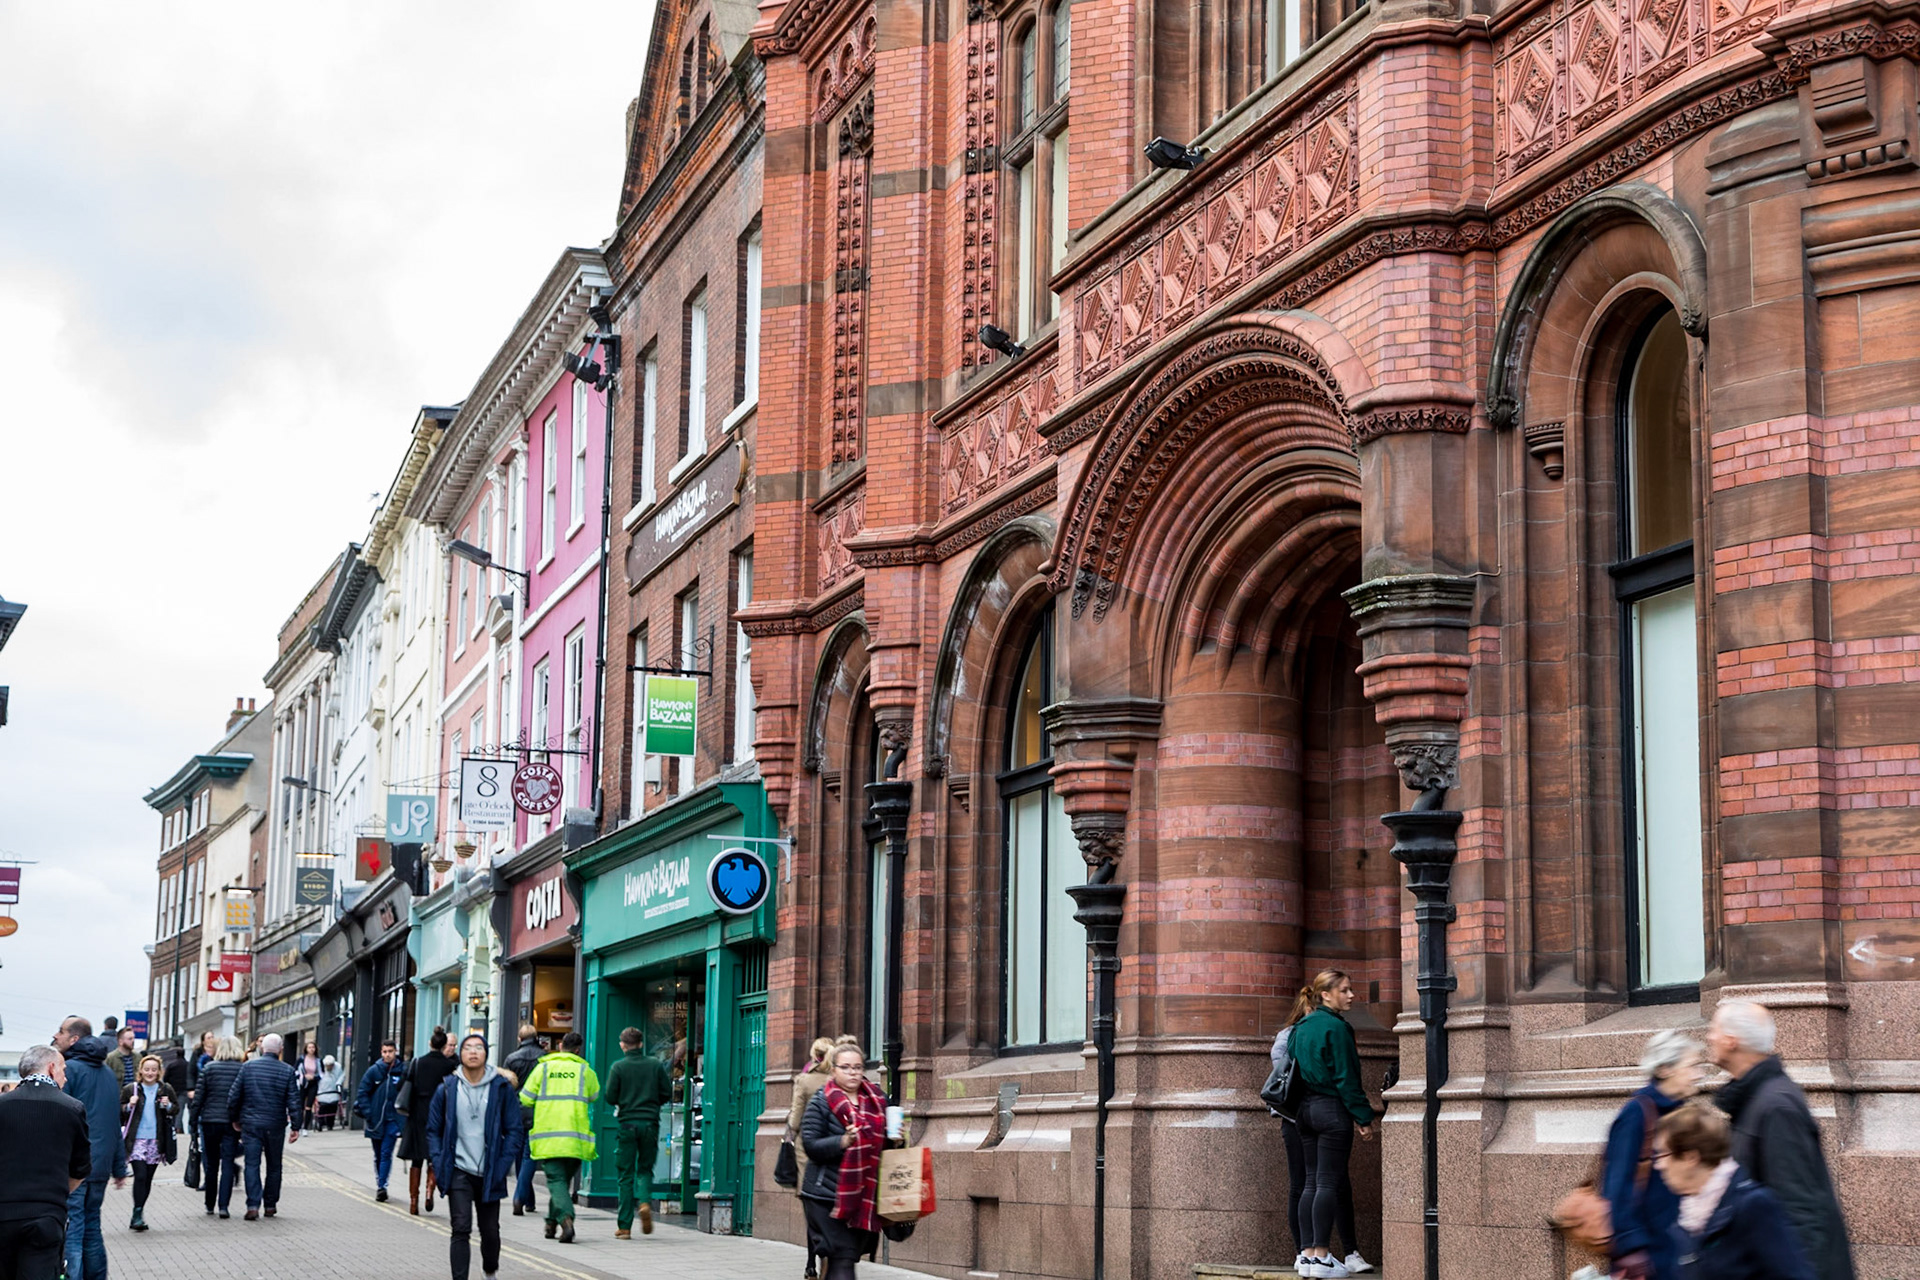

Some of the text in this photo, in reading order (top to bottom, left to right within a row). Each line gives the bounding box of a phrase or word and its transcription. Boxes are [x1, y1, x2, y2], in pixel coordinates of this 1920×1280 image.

[650, 708, 692, 723] BAZAAR
[477, 765, 499, 797] 8
[520, 766, 555, 782] COSTA
[517, 791, 557, 811] COFFEE
[391, 800, 430, 836] JOY
[464, 809, 511, 818] Restaurant
[659, 856, 690, 898] BAZAAR
[526, 876, 562, 930] COSTA
[654, 1001, 689, 1010] DRONE
[549, 1071, 576, 1079] AIRCO
